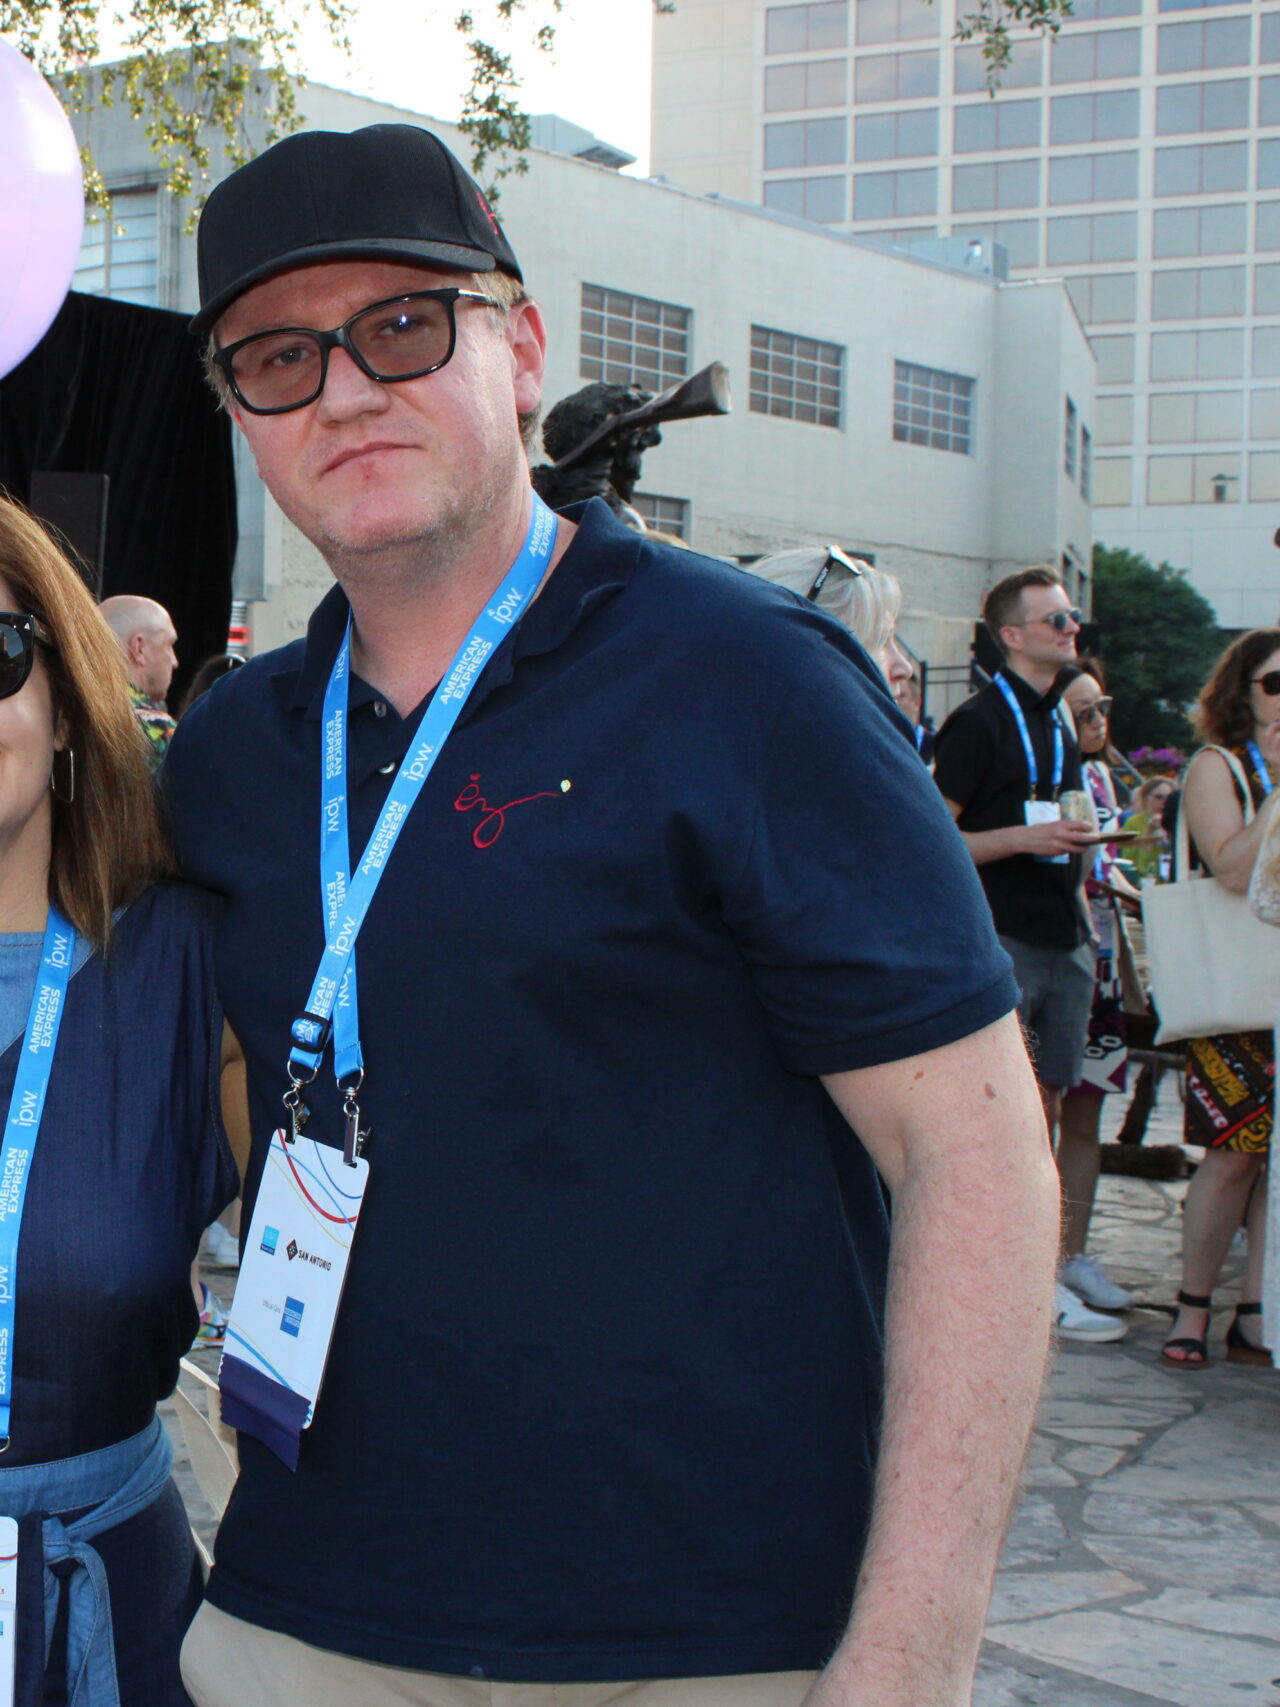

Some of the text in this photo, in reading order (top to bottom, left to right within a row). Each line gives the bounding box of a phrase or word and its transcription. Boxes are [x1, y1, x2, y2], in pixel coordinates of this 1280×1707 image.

[487, 587, 522, 624] ipw
[440, 636, 483, 705] AMERICAN
[453, 641, 493, 700] EXPRESS
[326, 720, 336, 780] EXPRESS
[333, 709, 343, 776] AMERICAN
[402, 742, 434, 782] ipw
[324, 795, 345, 833] ipw
[362, 801, 399, 875] AMERICAN
[372, 803, 407, 869] EXPRESS
[44, 933, 68, 969] ipw
[329, 916, 356, 957] ipw
[28, 985, 51, 1054] AMERICAN
[40, 988, 61, 1048] EXPRESS
[11, 1090, 38, 1127] ipw
[7, 1149, 28, 1214] EXPRESS
